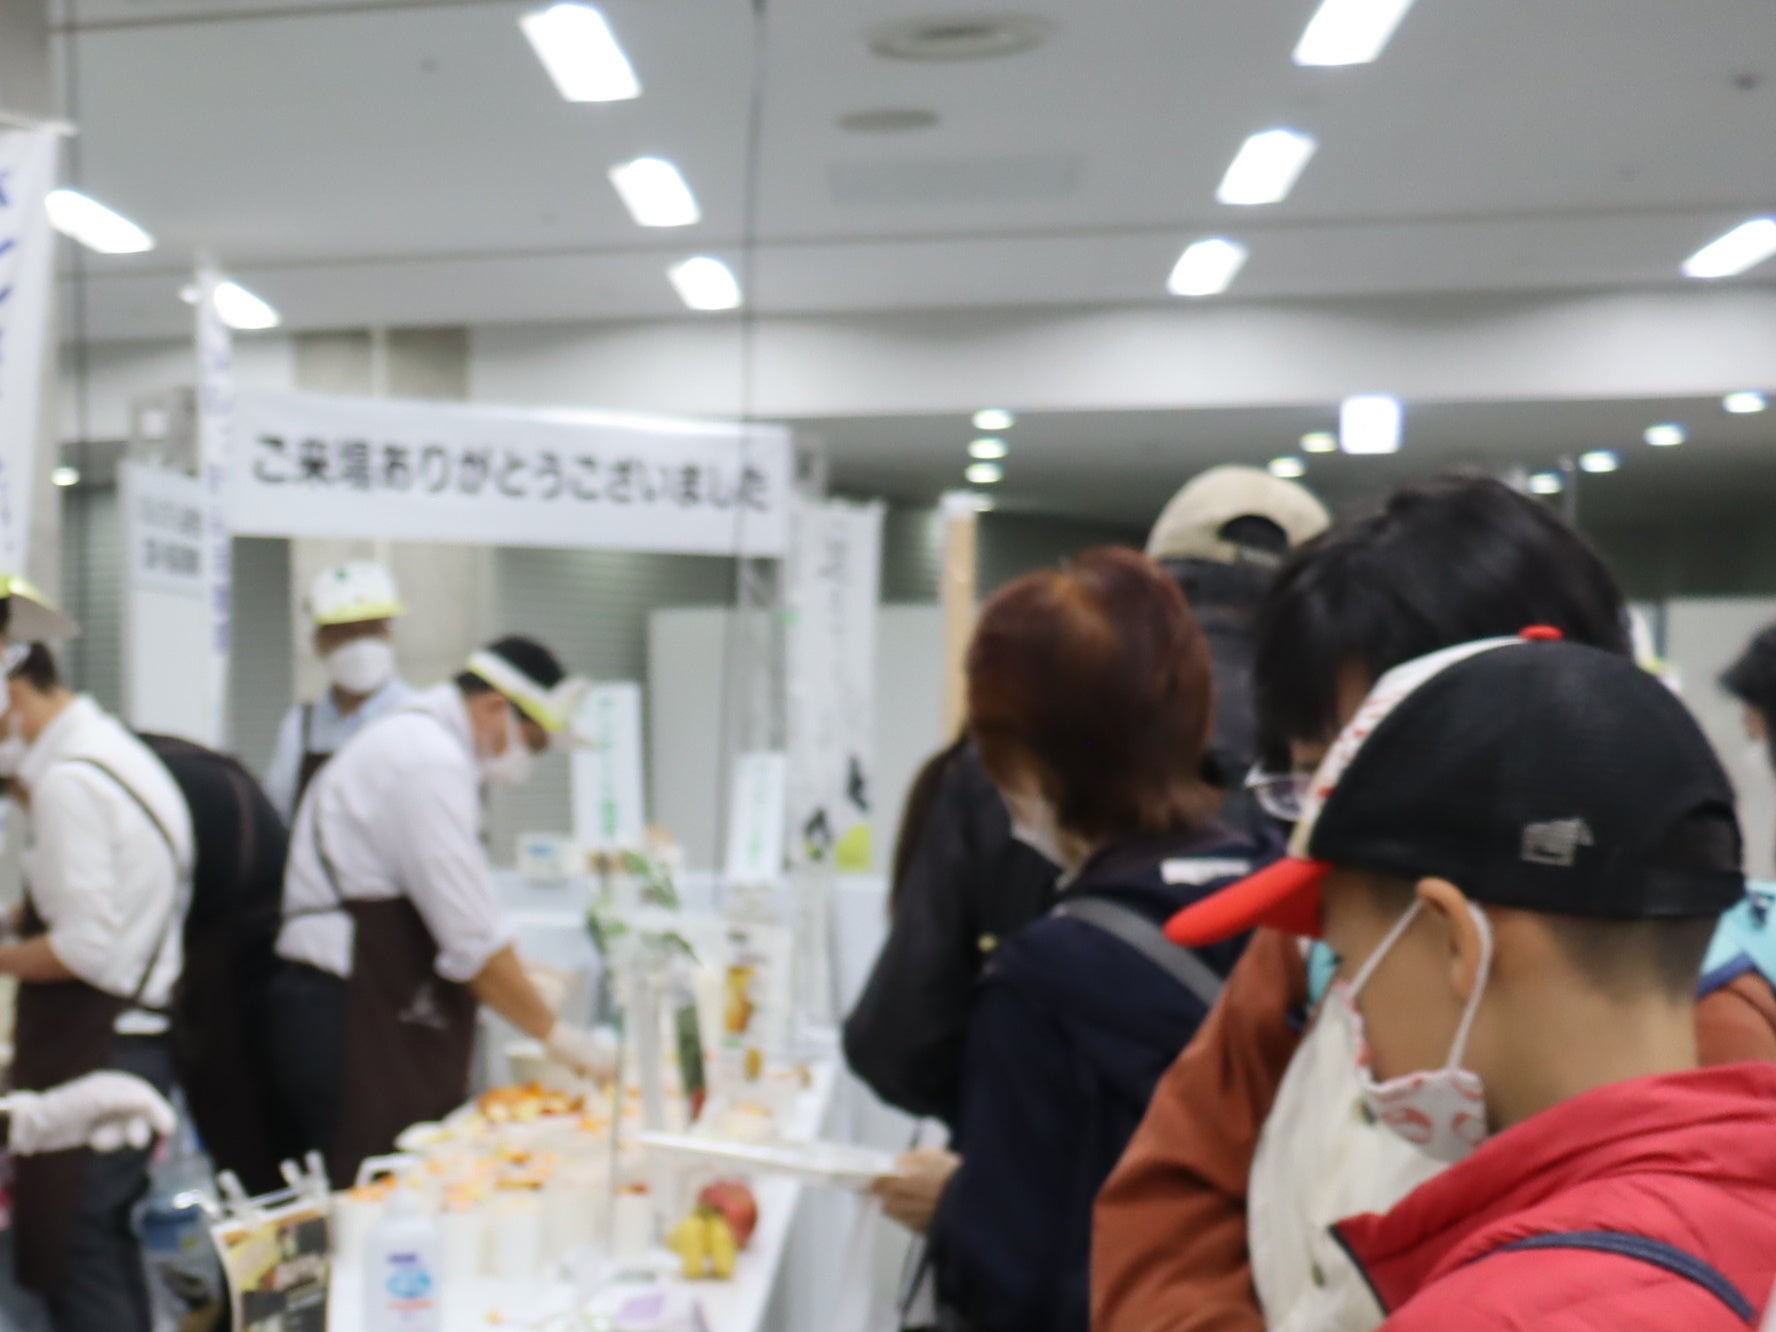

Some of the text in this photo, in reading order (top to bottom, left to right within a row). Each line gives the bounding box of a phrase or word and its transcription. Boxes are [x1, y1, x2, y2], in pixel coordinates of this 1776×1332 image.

[251, 434, 770, 512] ご来場ありがとうございました
